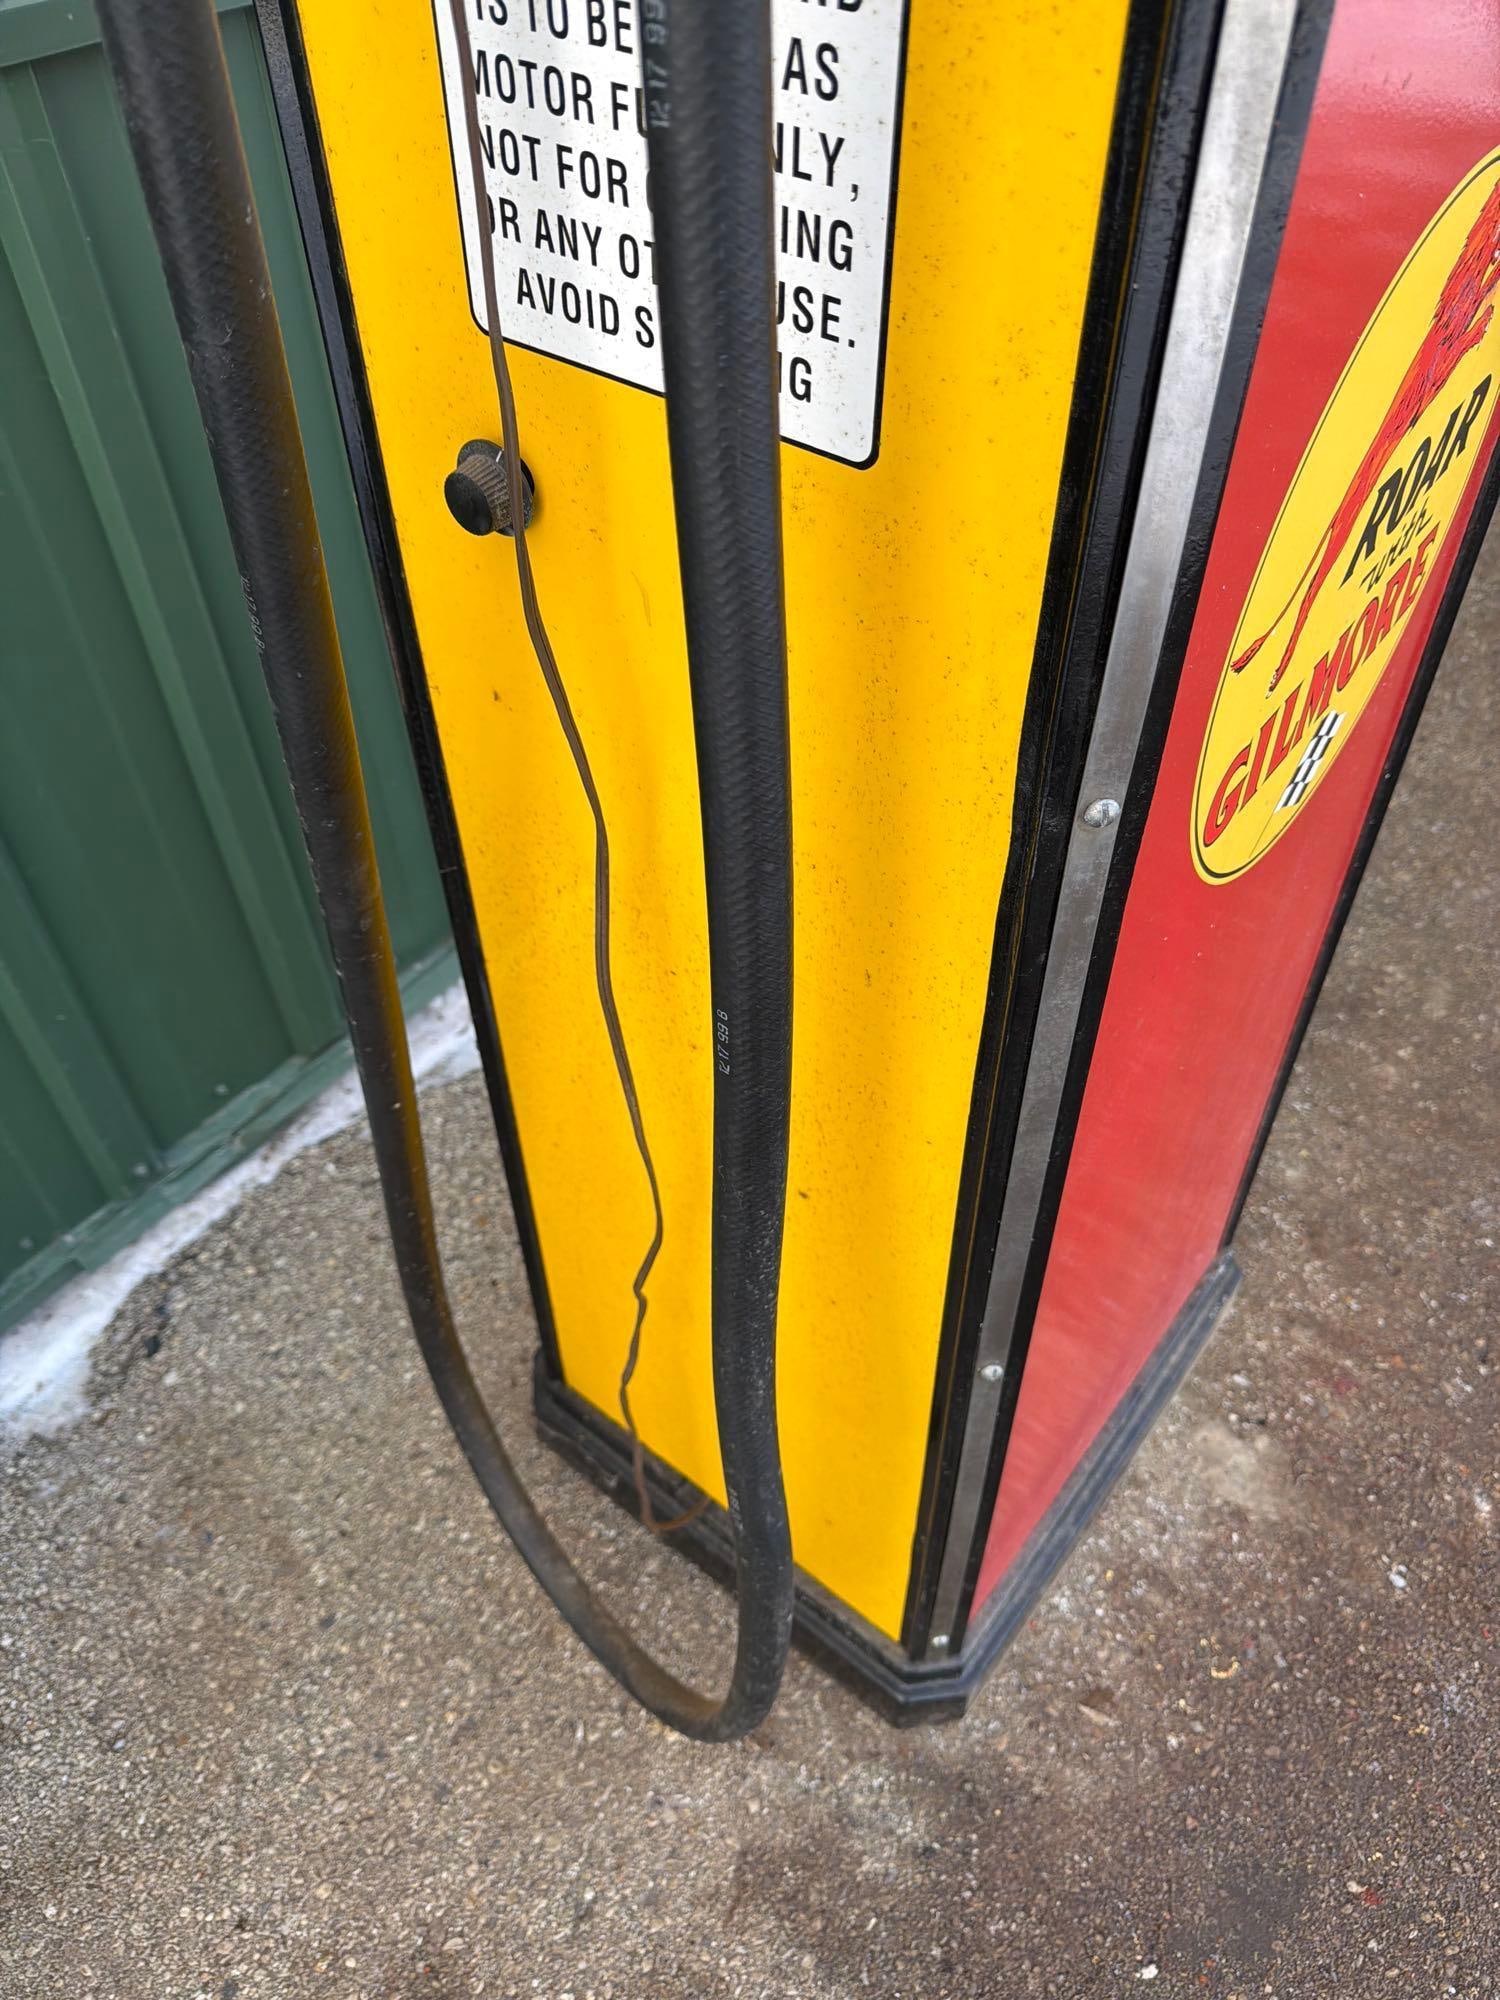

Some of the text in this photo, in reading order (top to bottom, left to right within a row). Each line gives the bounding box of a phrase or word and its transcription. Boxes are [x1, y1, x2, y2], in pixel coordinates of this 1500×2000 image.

[586, 0, 633, 54] BE
[781, 37, 839, 101] AS
[475, 49, 595, 125] MOTOR
[773, 122, 859, 202] NLY,
[480, 124, 541, 181] NOT
[556, 143, 629, 208] FOR
[486, 193, 521, 244] R
[535, 208, 602, 267] ANY
[517, 267, 619, 336] AVOID
[1339, 373, 1492, 590] ROAR
[1203, 520, 1440, 848] GILMORE
